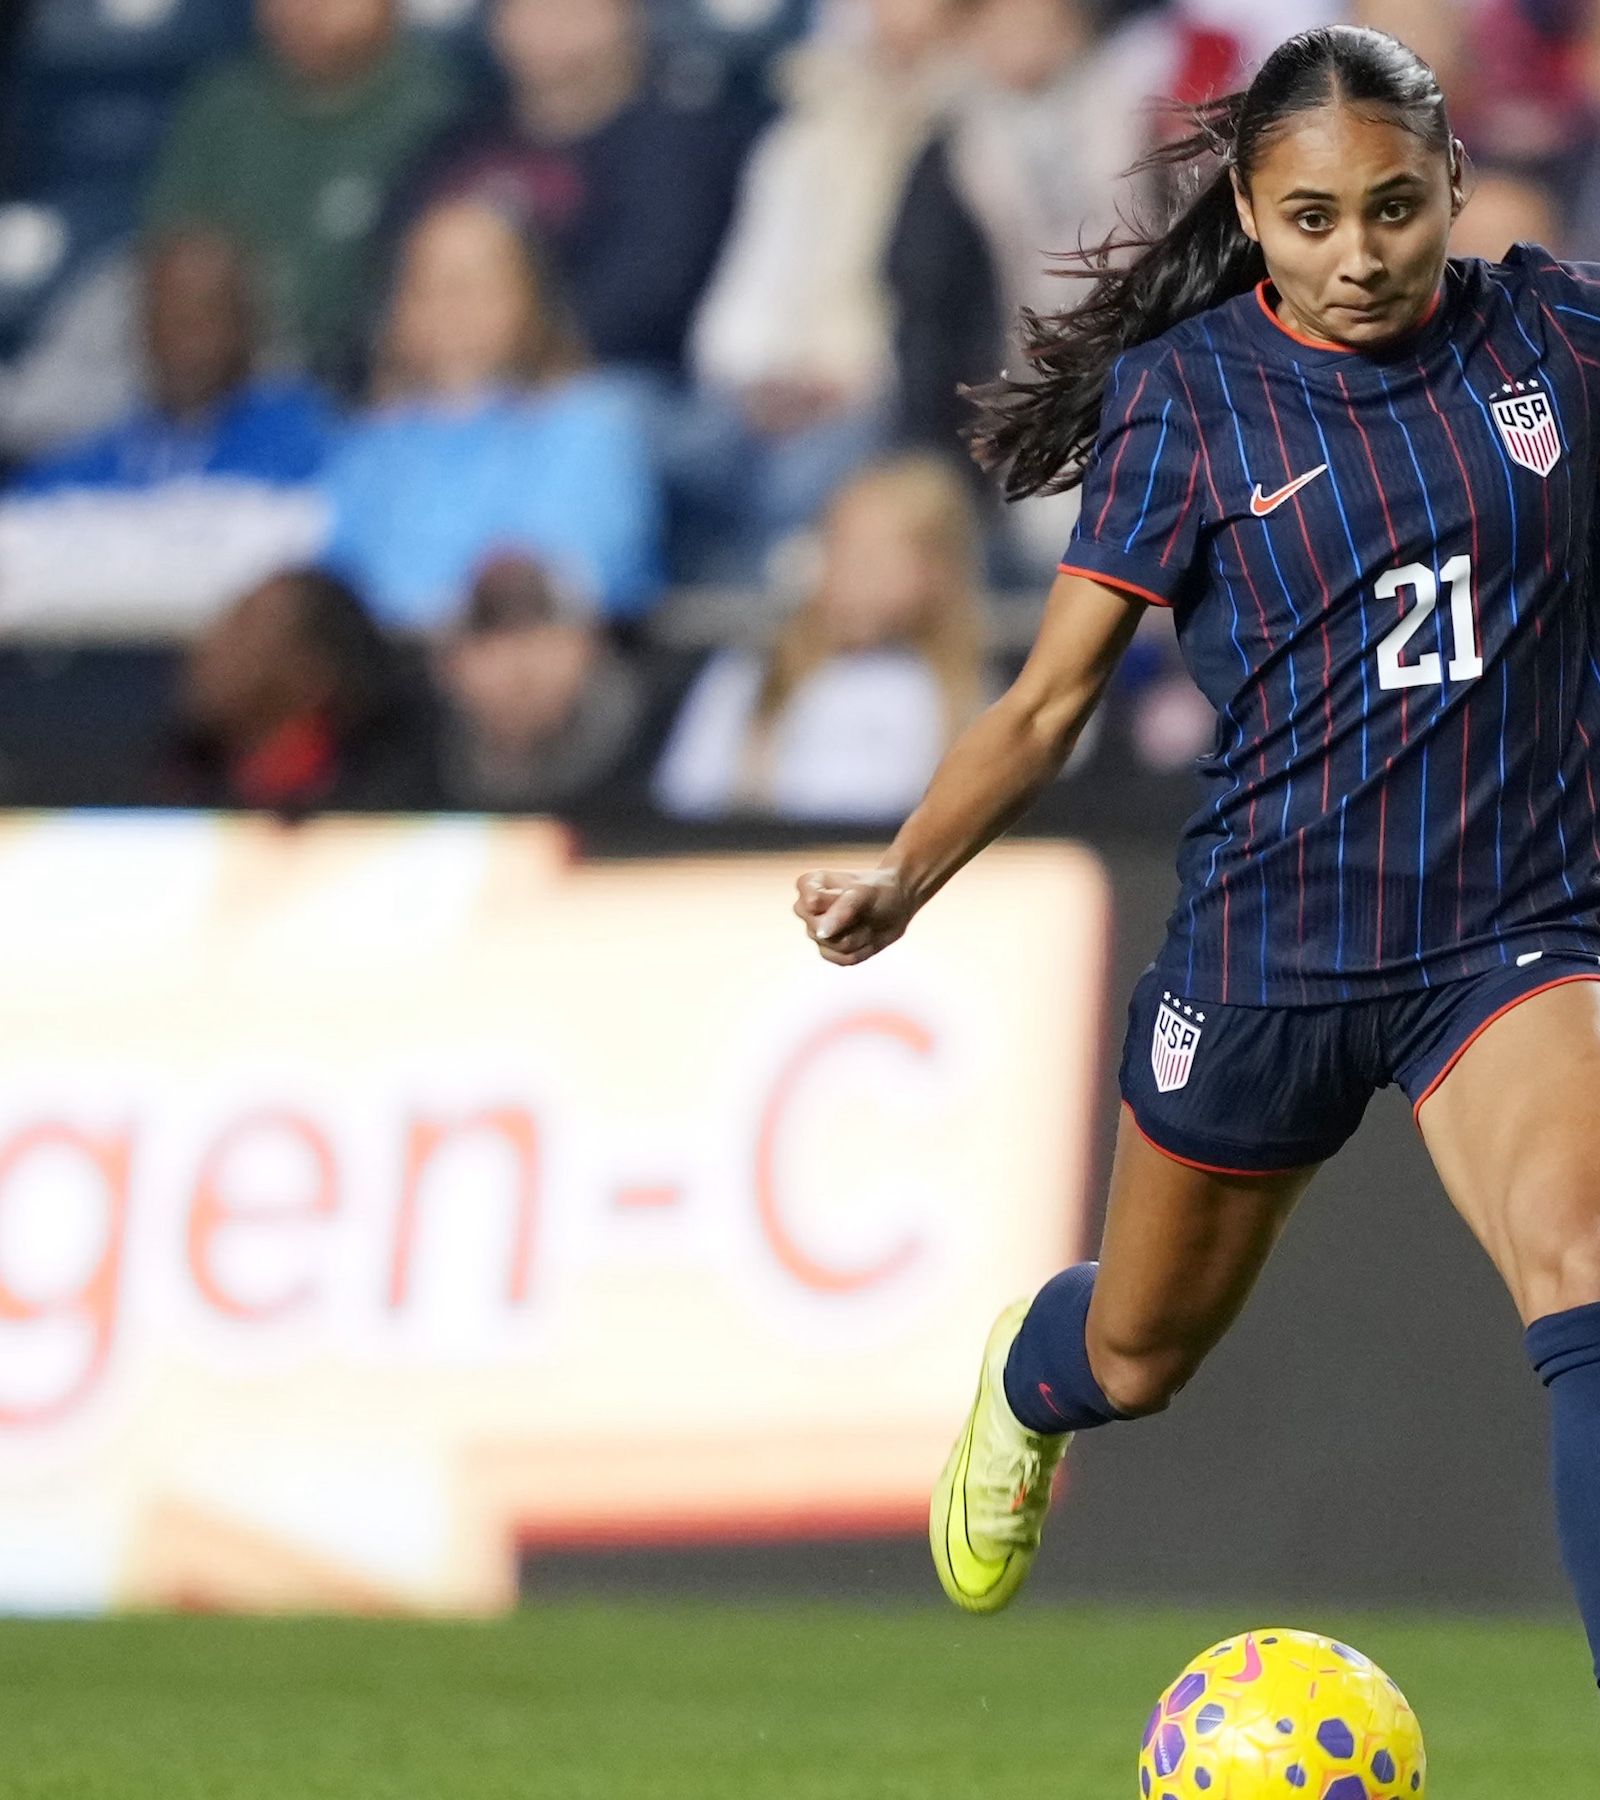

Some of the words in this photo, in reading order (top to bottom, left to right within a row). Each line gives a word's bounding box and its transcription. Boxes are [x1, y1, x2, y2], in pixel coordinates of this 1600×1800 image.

[1498, 399, 1547, 430] USA
[1374, 554, 1483, 690] 21
[1159, 1010, 1195, 1050] USA
[0, 1008, 940, 1432] gen-C
